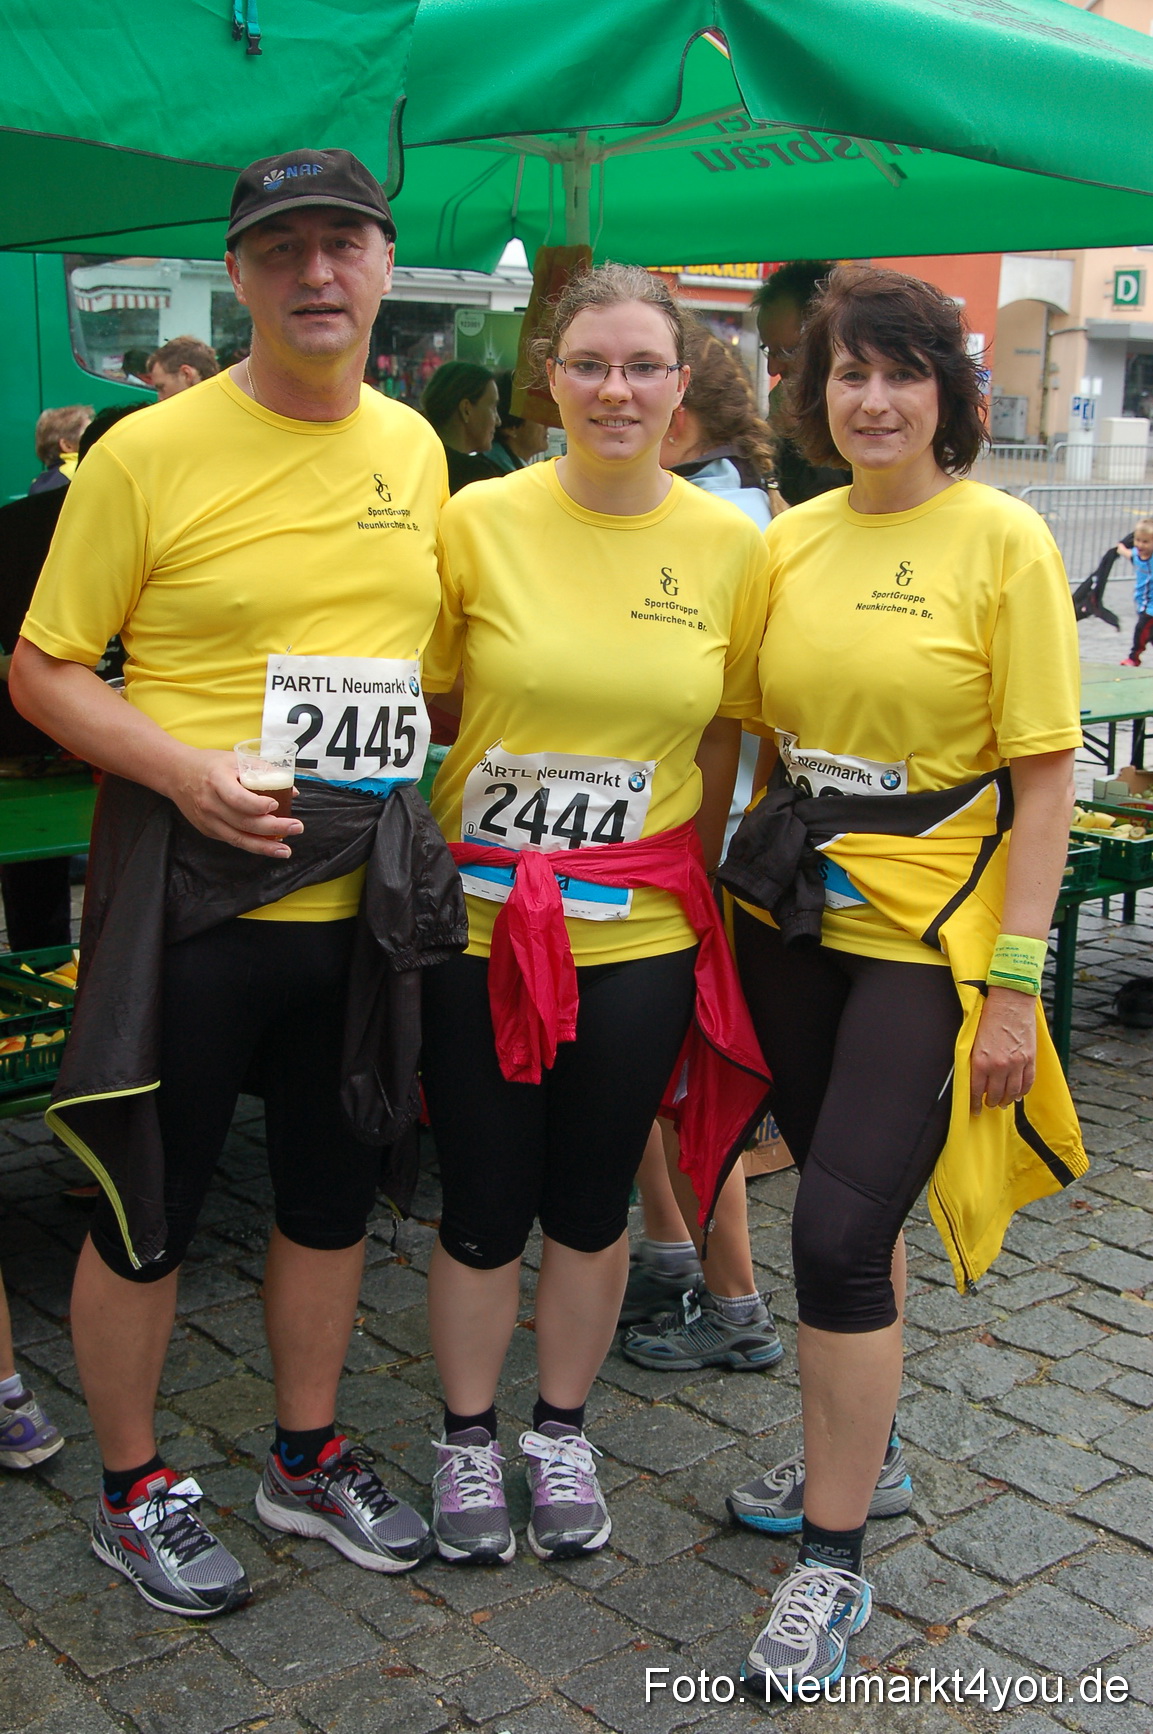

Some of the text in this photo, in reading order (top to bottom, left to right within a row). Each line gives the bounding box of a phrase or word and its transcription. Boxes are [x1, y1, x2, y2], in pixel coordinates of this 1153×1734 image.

[1116, 274, 1138, 302] D
[357, 520, 406, 531] Neunkirchen
[644, 597, 699, 616] SportGruppe
[871, 590, 926, 604] SportGruppe
[630, 610, 708, 632] Neunkirchen a. Br.
[855, 602, 934, 620] Neunkirchen a. Br.
[271, 674, 337, 694] PARTL
[342, 677, 408, 695] Neumarkt
[286, 703, 417, 771] 2445
[536, 766, 621, 788] Neumarkt
[797, 755, 873, 787] Neumarkt
[478, 782, 630, 850] 2444
